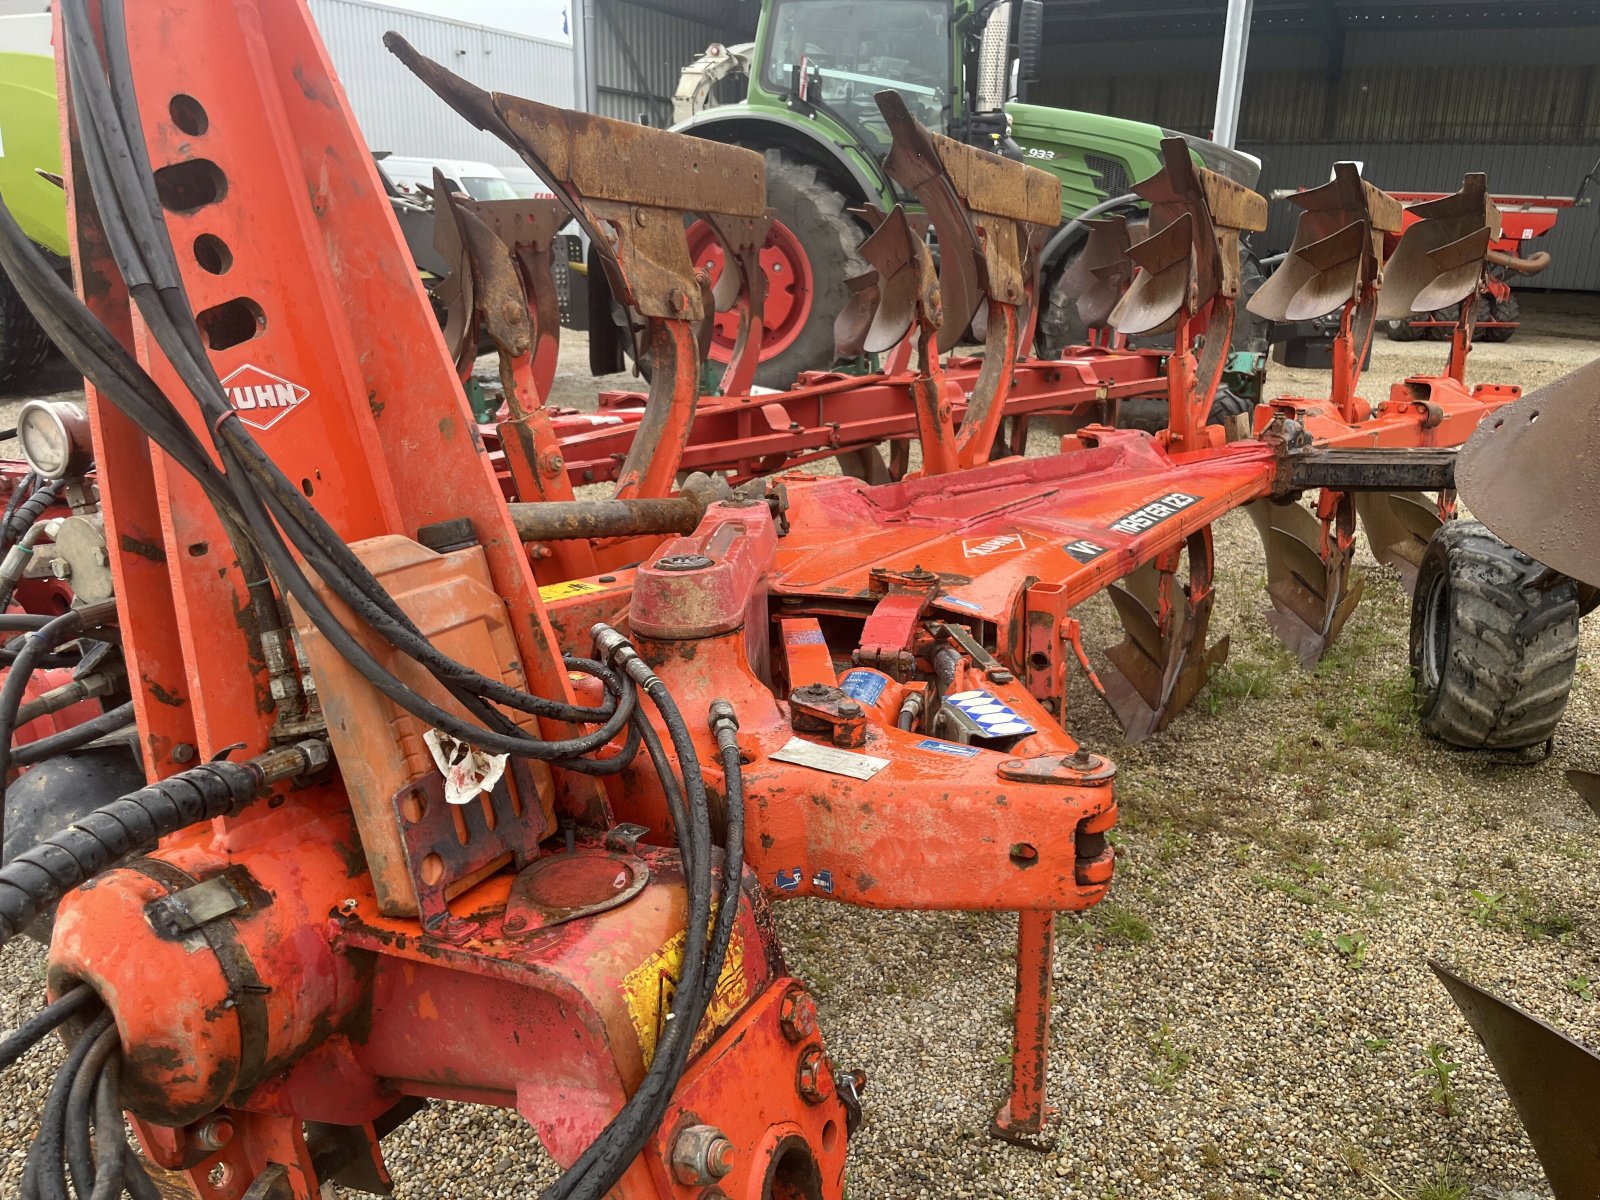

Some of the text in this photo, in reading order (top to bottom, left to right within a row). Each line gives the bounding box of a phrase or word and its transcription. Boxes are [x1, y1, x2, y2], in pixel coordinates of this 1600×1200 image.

[1029, 148, 1055, 160] 933
[1110, 502, 1177, 535] MASTER
[1161, 493, 1195, 508] 123
[966, 535, 1019, 555] KUHN
